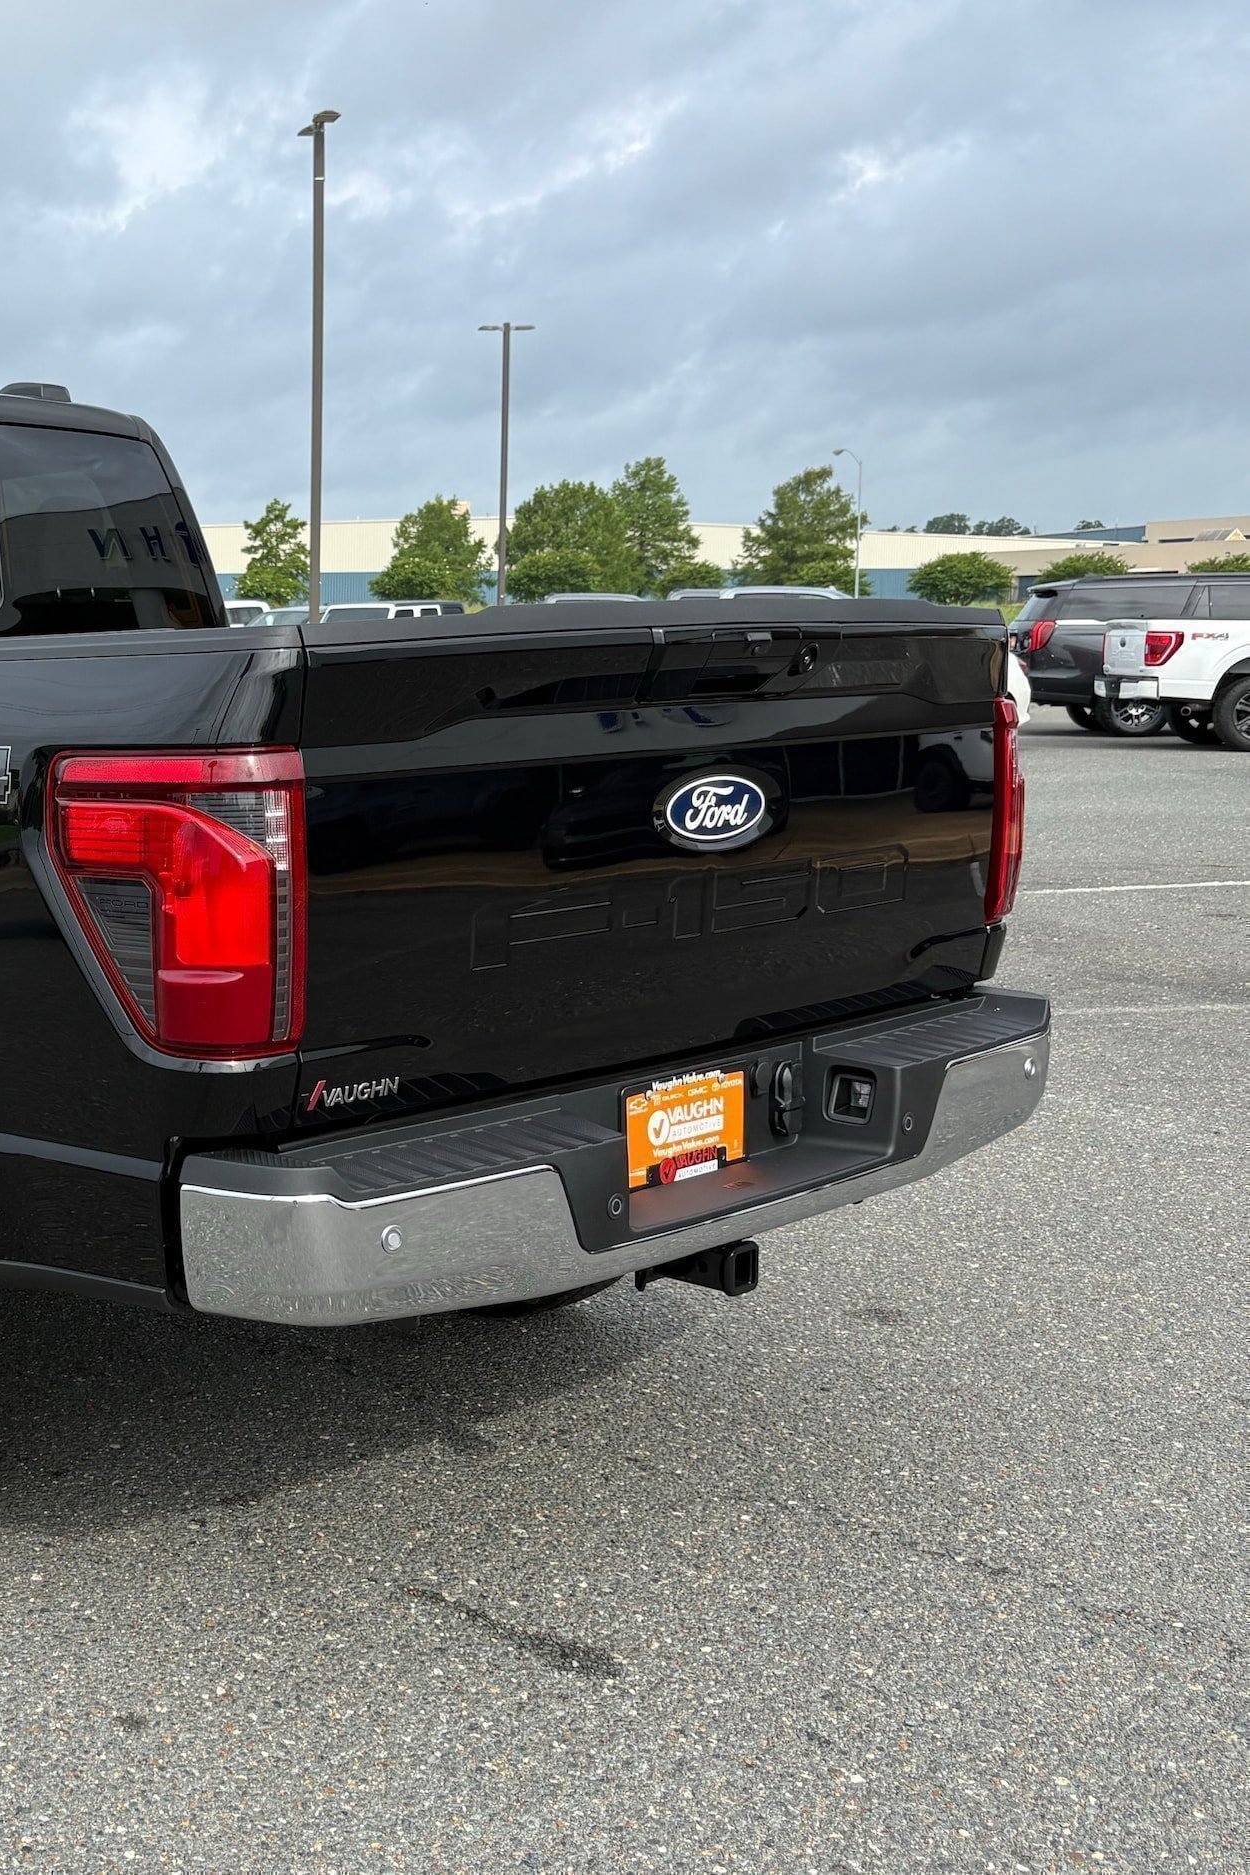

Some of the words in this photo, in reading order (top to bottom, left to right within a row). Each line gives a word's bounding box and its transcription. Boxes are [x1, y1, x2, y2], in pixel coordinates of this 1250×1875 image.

[684, 785, 750, 831] Ford
[322, 1076, 400, 1108] VAUGHN
[668, 1096, 725, 1125] VAUGHN
[672, 1118, 722, 1136] AUTOMOTIVE
[652, 1135, 720, 1158] VaughnValue.com
[675, 1145, 718, 1168] VAUGHN
[678, 1163, 718, 1179] AUTOMOTIVE
